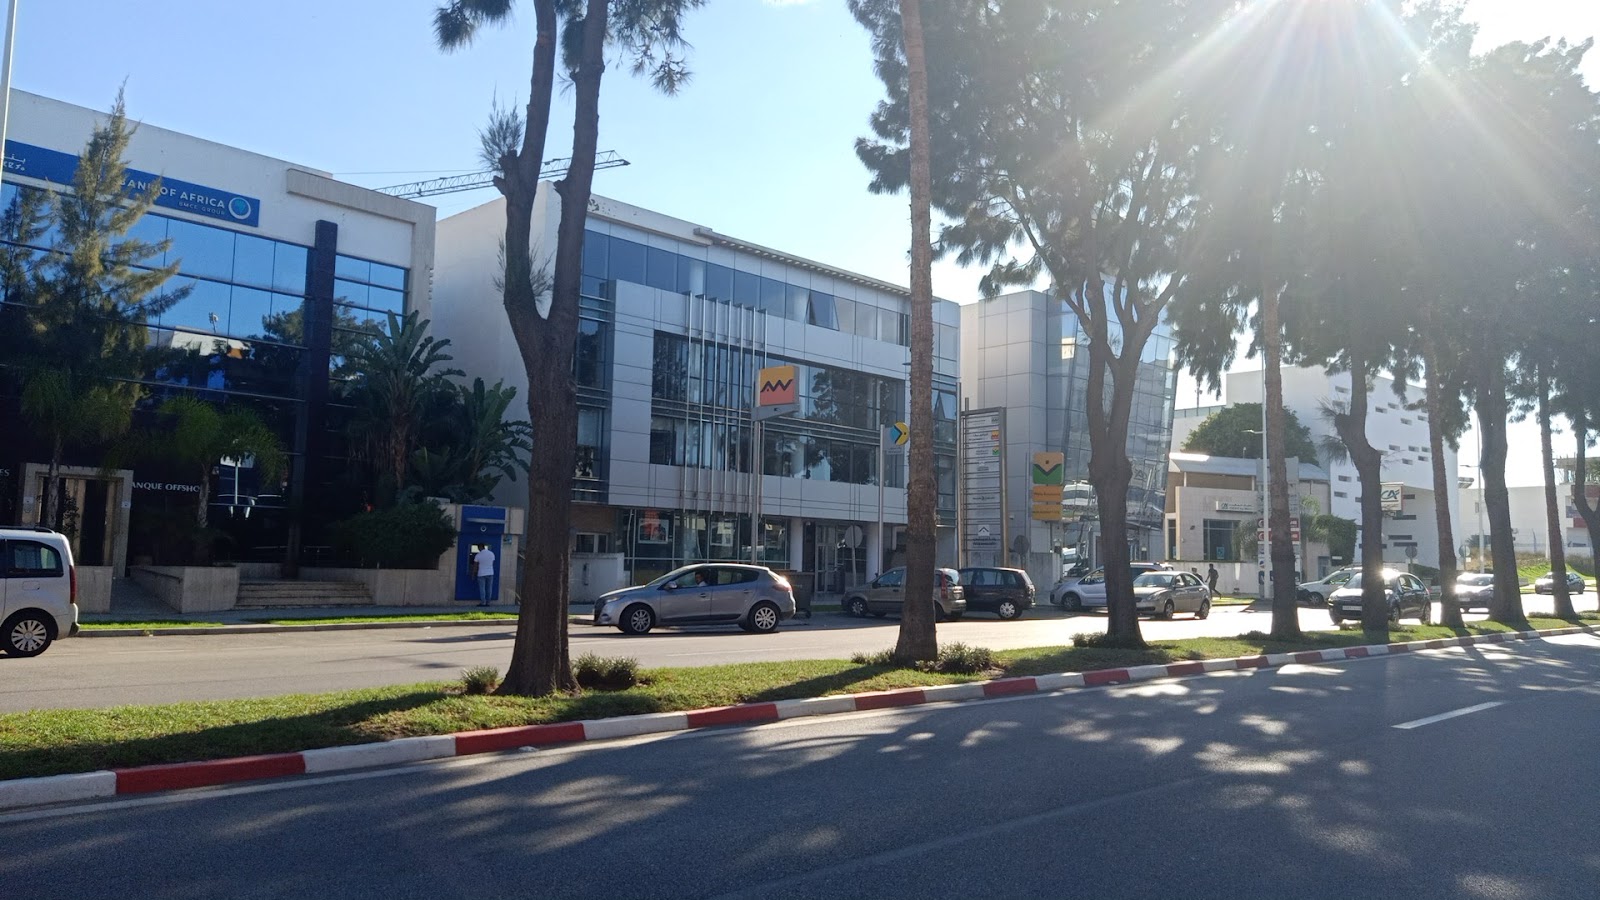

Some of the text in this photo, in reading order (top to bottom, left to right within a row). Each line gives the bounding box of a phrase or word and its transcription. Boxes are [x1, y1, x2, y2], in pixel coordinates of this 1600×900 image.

[161, 186, 176, 197] OF
[180, 191, 225, 208] AFRICA
[131, 481, 200, 493] ANQUE OFFSHO
